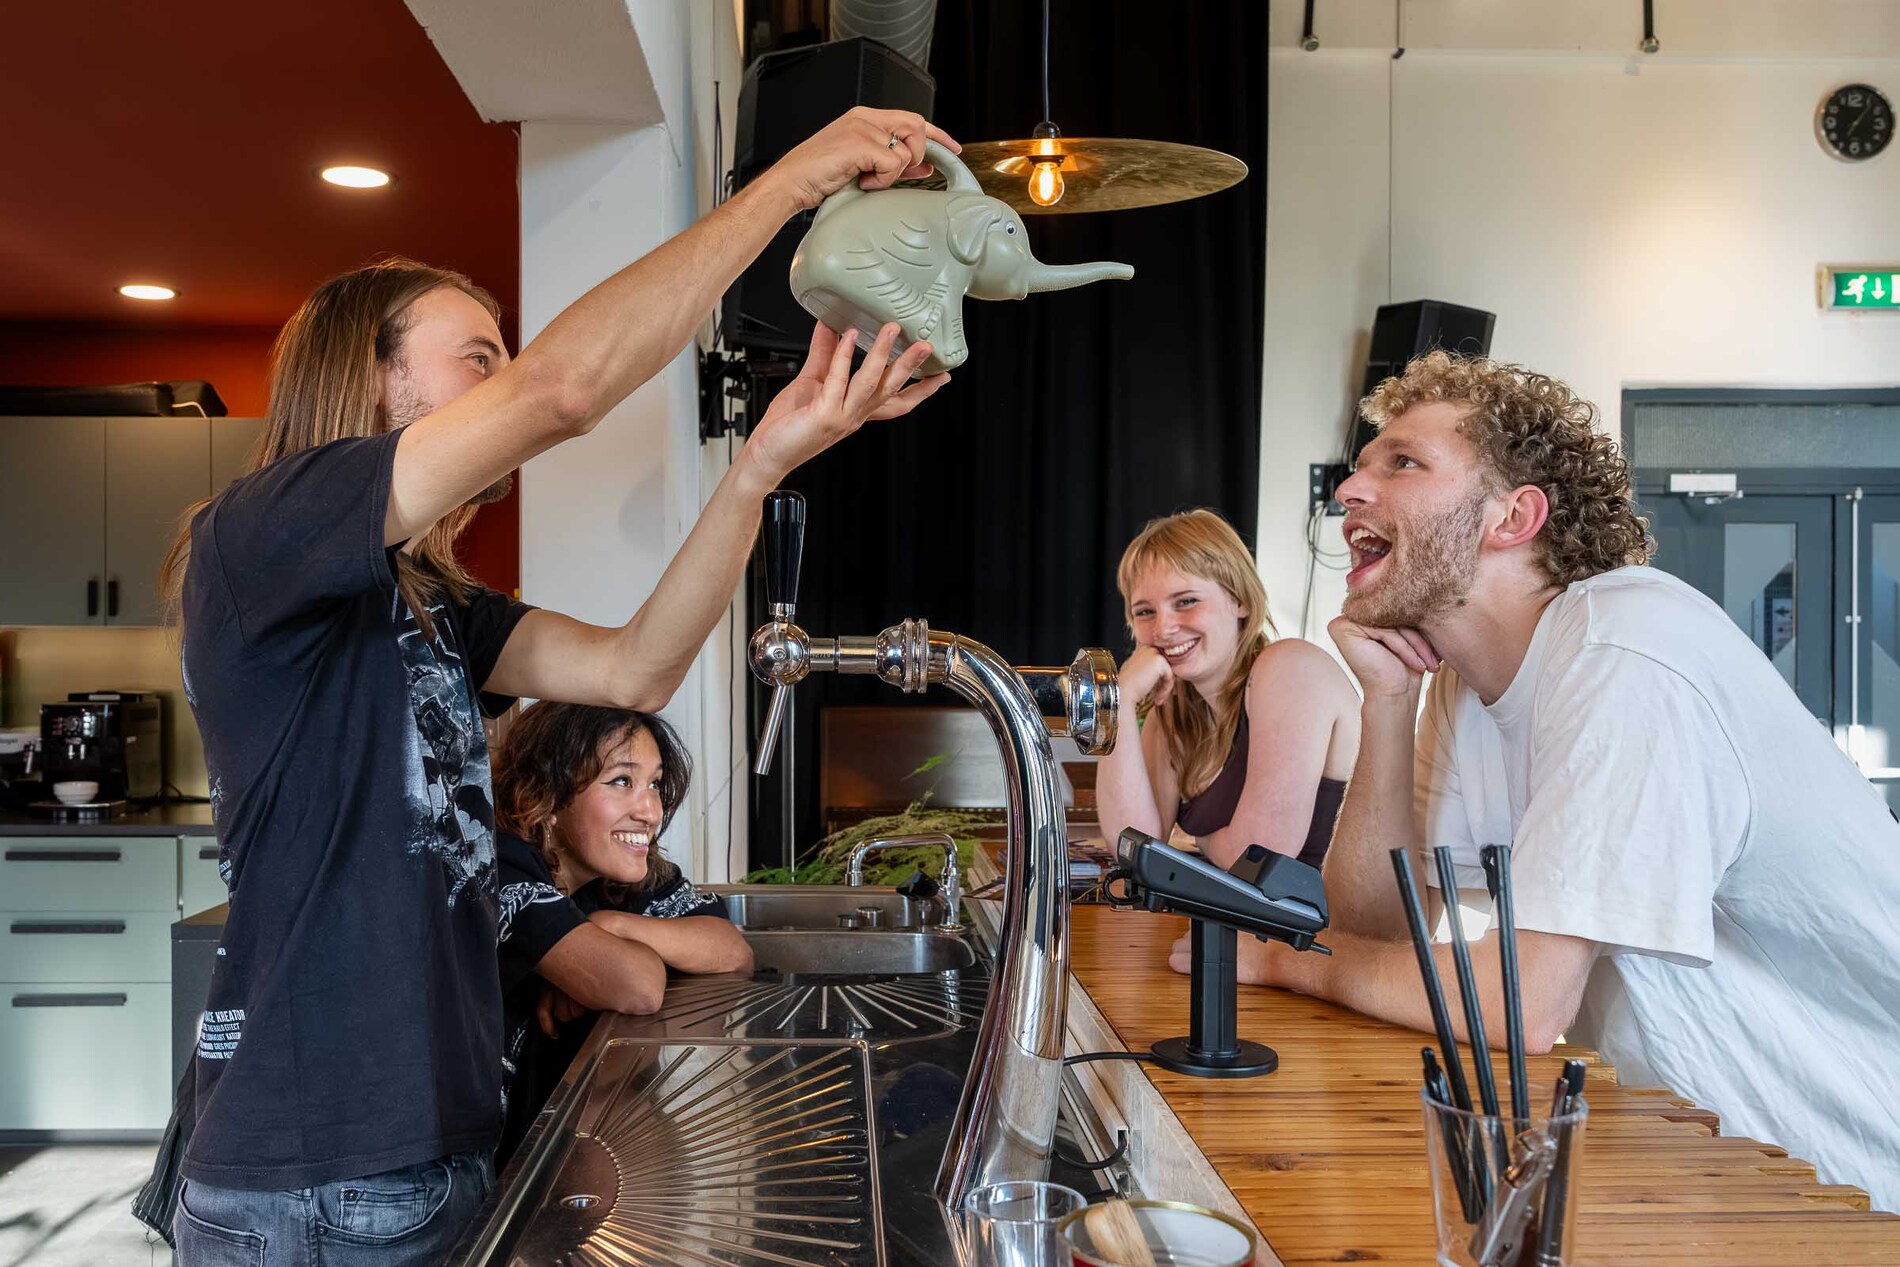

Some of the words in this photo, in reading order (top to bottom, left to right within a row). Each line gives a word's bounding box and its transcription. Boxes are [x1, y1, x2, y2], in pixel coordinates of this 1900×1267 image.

[1847, 93, 1863, 107] 12
[1825, 116, 1837, 129] 9
[1873, 117, 1886, 130] 3
[1849, 141, 1860, 155] 6
[215, 1009, 245, 1022] KREATOR
